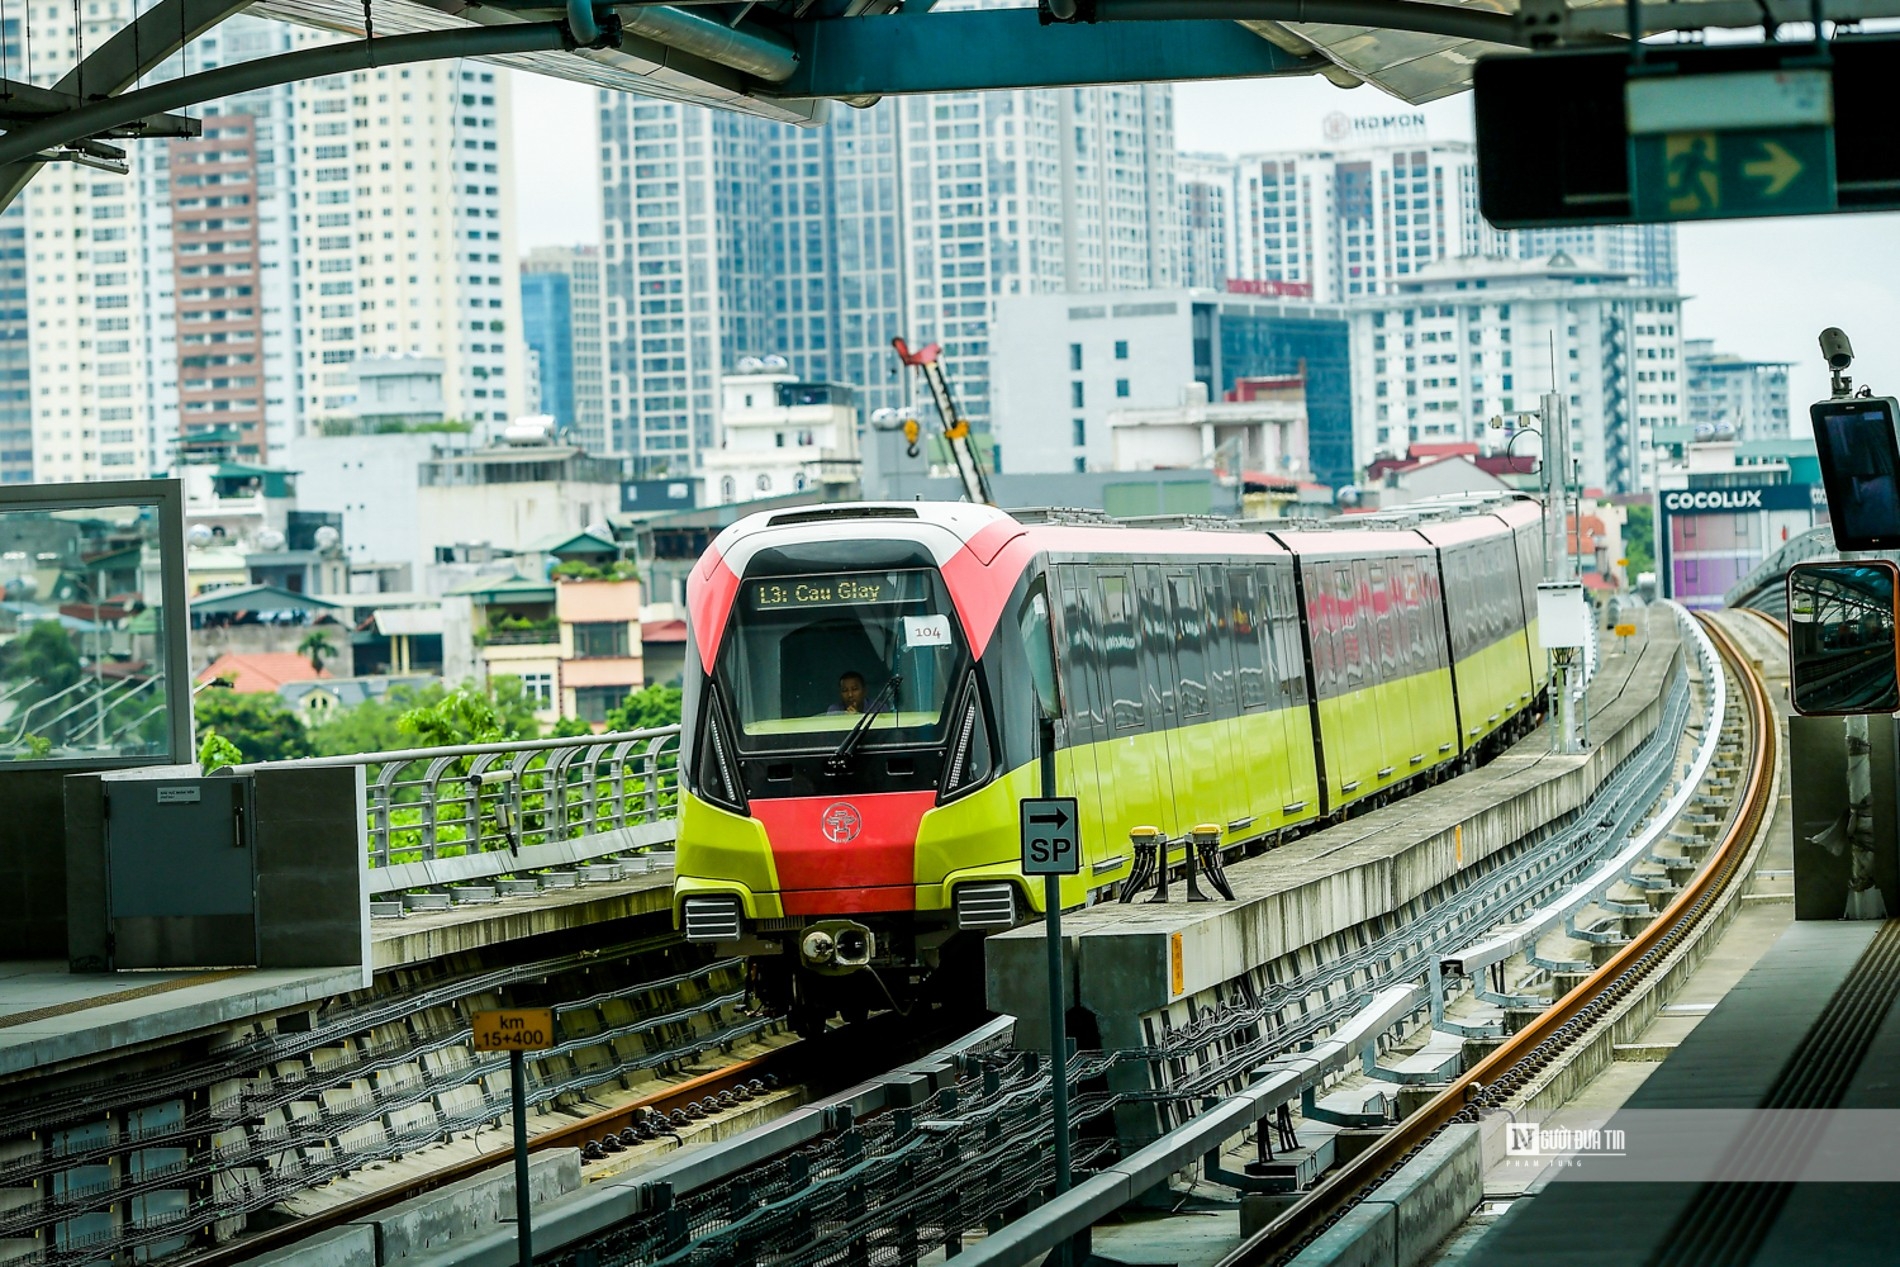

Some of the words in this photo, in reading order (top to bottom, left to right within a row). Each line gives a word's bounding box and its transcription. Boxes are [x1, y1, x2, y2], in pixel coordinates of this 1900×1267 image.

[1665, 489, 1762, 510] COCOLUX
[760, 586, 787, 604] L3:
[795, 584, 831, 602] Cau
[915, 626, 941, 639] 104
[1030, 838, 1071, 863] SP
[500, 1015, 524, 1029] km
[482, 1029, 544, 1046] 15+400
